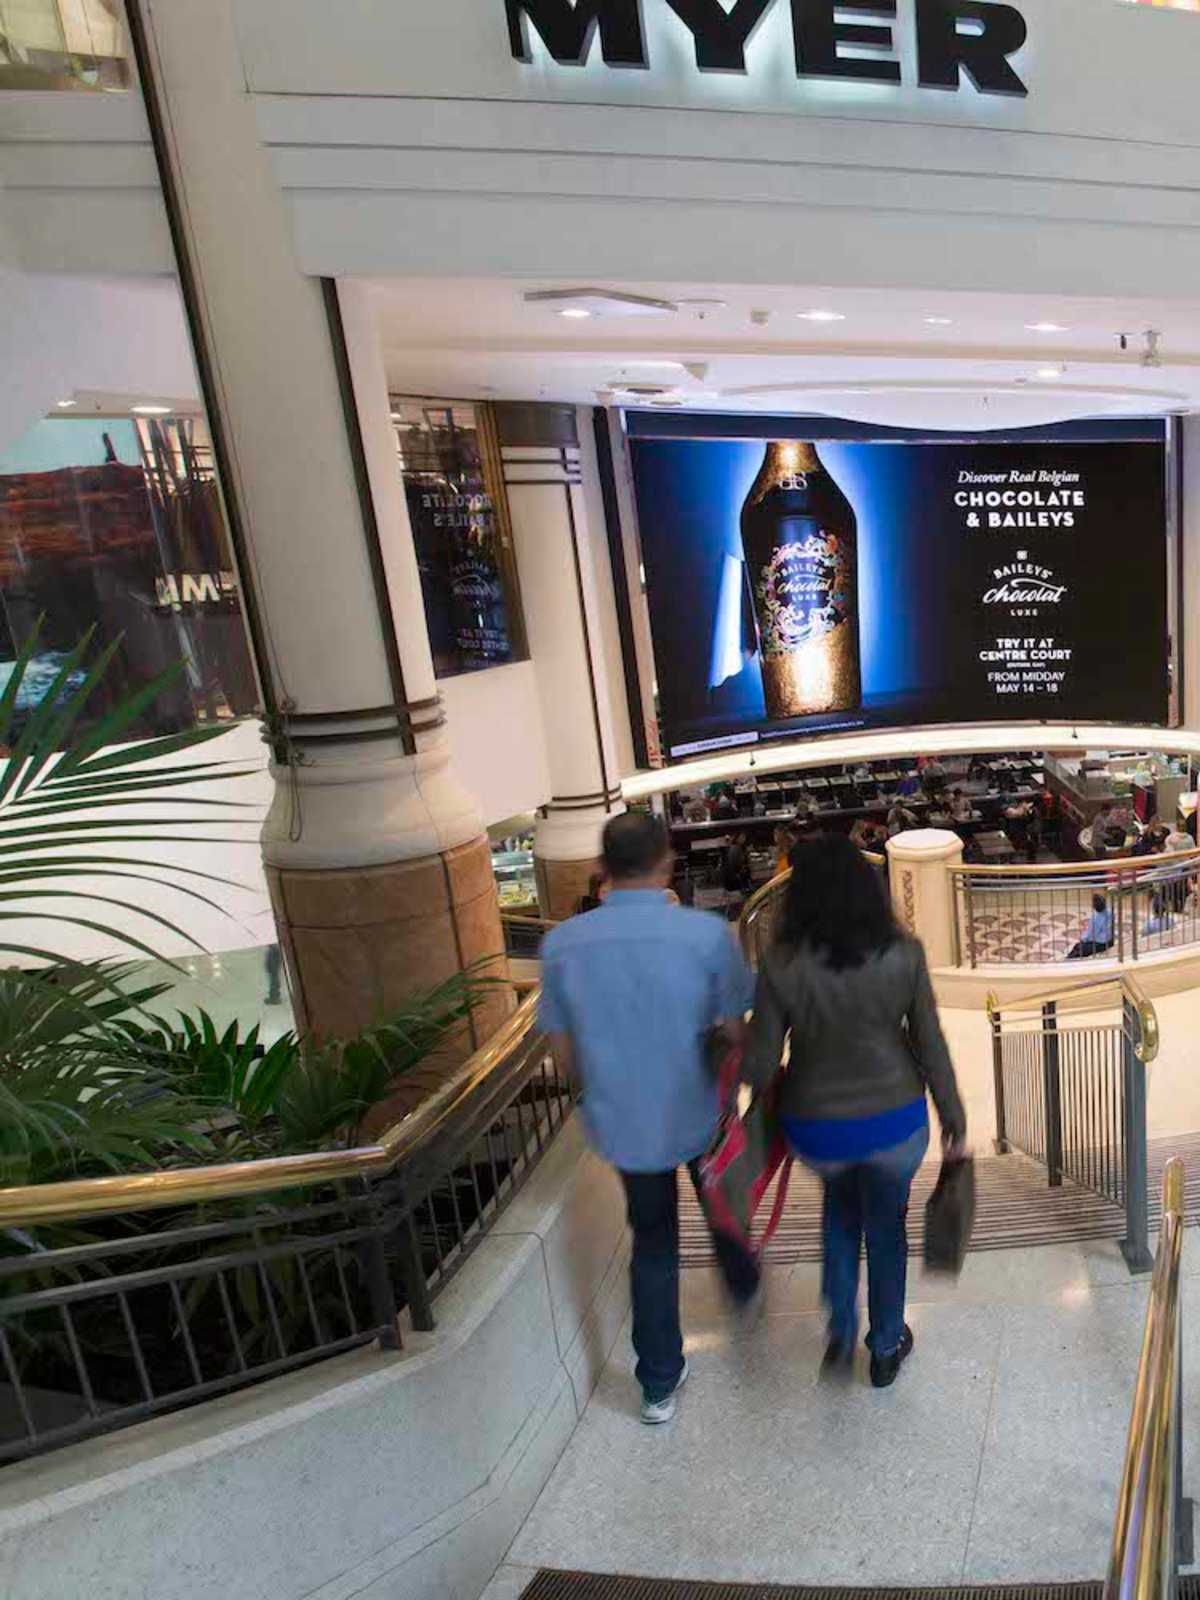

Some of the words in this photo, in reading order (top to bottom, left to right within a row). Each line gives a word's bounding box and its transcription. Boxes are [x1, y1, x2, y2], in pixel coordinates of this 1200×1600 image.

[506, 0, 1028, 98] MYER
[958, 470, 1006, 483] Discover
[1009, 470, 1036, 482] Real
[1037, 470, 1079, 486] Belgian
[954, 490, 1085, 507] CHOCOLATE
[966, 512, 980, 527] &
[988, 512, 1074, 527] BAILEYS
[1010, 608, 1038, 617] LUXE
[996, 638, 1020, 649] TRY
[1024, 638, 1036, 649] IT
[1038, 638, 1054, 649] AT
[979, 651, 1027, 661] CENTRE
[1030, 650, 1072, 660] COURT
[987, 672, 1019, 682] FROM
[1022, 671, 1065, 682] MIDDAY
[996, 683, 1020, 693] MAY
[1023, 683, 1034, 693] 14
[1046, 683, 1058, 693] 18
